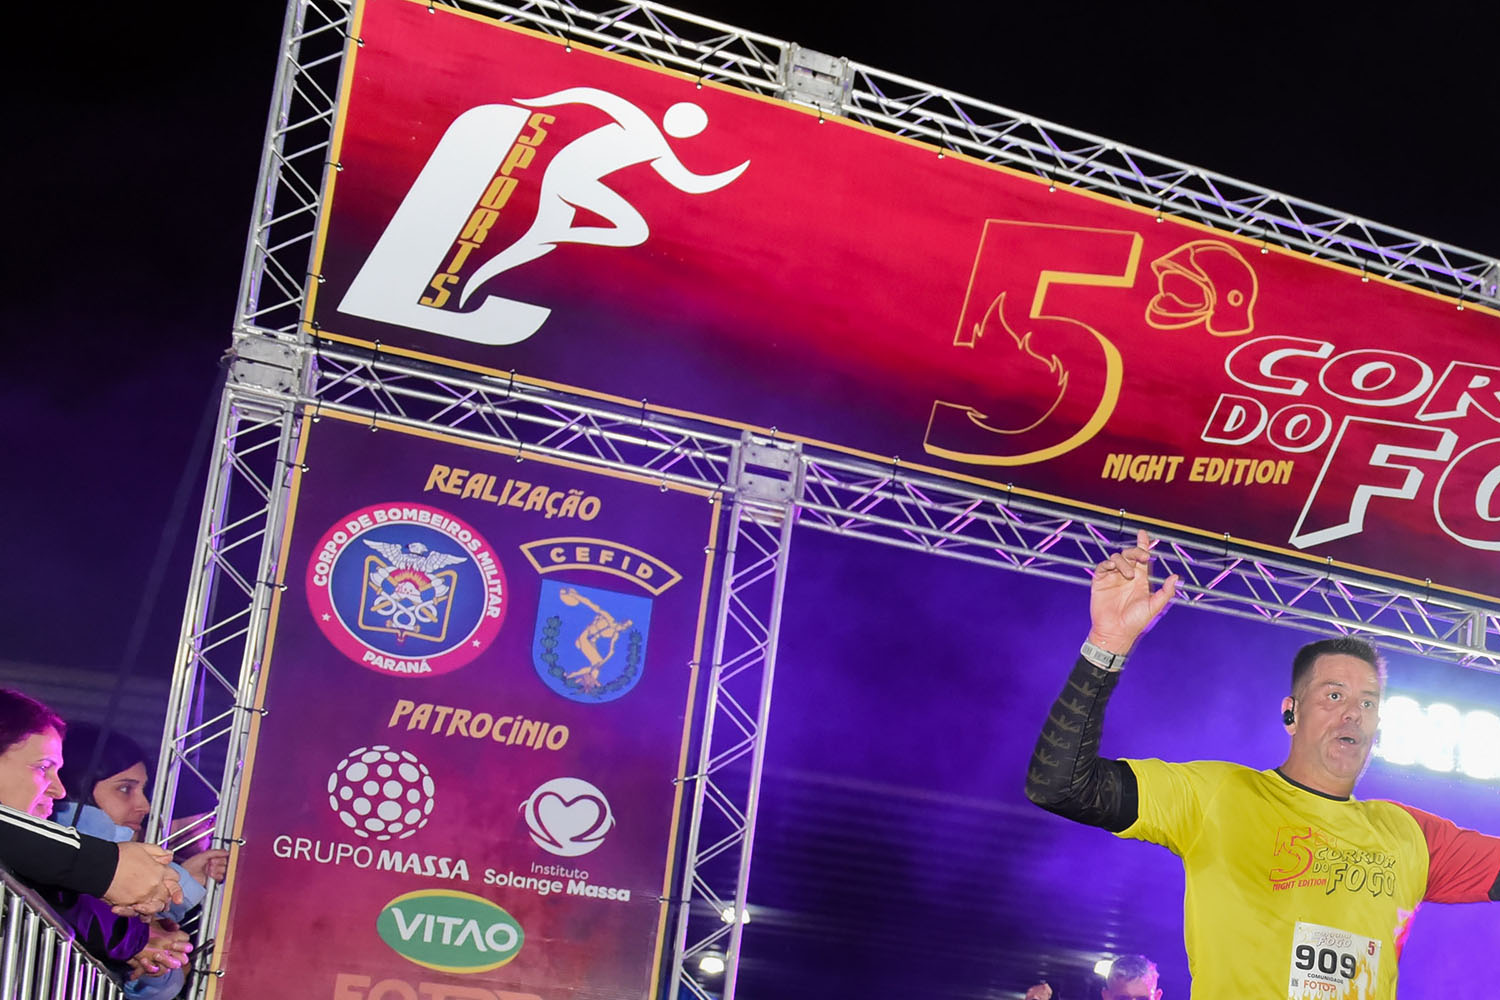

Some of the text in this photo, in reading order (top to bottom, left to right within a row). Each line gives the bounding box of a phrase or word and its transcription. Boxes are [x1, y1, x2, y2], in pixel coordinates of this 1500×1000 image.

[419, 112, 555, 309] SPORTS
[923, 218, 1144, 467] 5
[1201, 393, 1333, 453] DO
[1101, 453, 1294, 486] NIGHT EDITION
[424, 464, 601, 521] REALIZAÇÃO
[313, 507, 503, 619] CORPO DE BOMBEIROS MILITAR
[550, 547, 655, 580] CEFID
[362, 650, 432, 675] PARANÁ
[389, 698, 570, 751] PATROCÍNIO
[273, 835, 470, 881] GRUPO MASSA
[531, 862, 589, 880] Instituto
[1312, 861, 1330, 873] DO
[1314, 846, 1396, 869] CORRIDA
[483, 868, 631, 902] Solange Massa
[1326, 862, 1396, 897] FOGO
[391, 907, 518, 952] VITAO
[1295, 944, 1357, 980] 909
[1367, 940, 1375, 956] 5
[1307, 972, 1344, 985] COMUNIDADE
